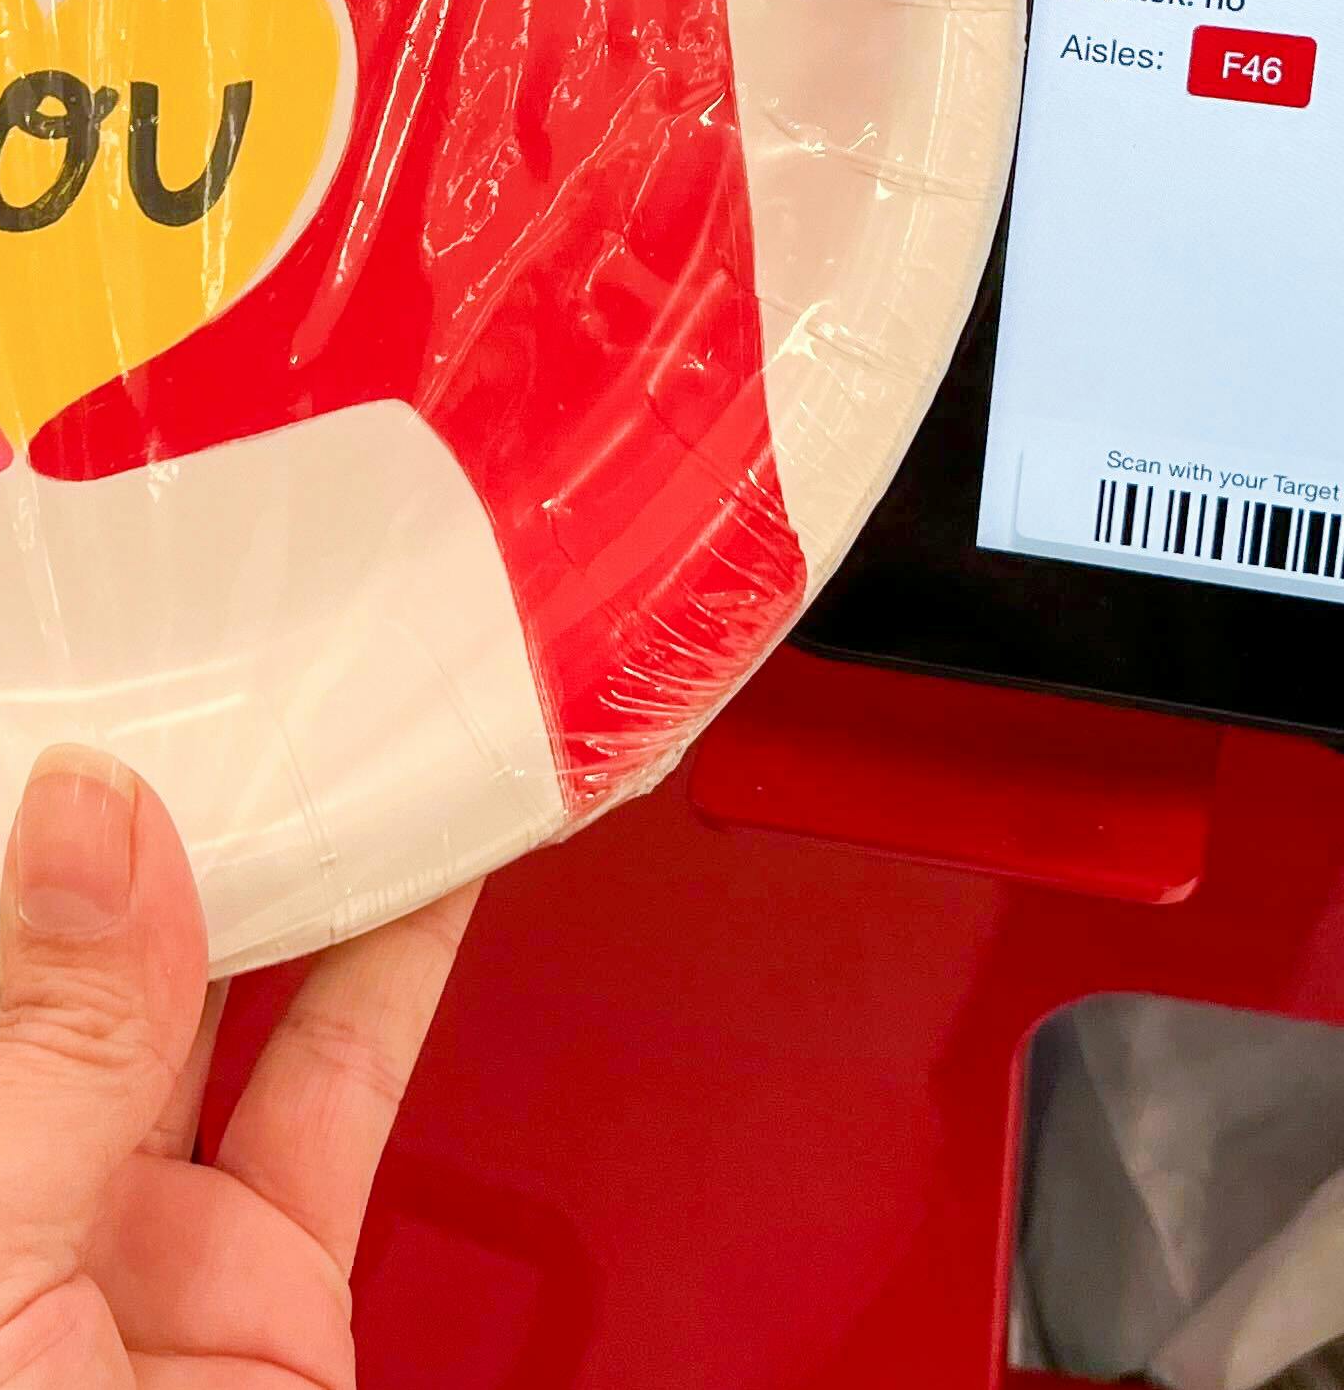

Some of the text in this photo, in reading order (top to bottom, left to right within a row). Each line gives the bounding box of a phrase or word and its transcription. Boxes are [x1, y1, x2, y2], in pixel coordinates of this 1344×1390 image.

[1060, 34, 1283, 83] Aisles: F46
[1107, 450, 1161, 476] Scan
[1168, 458, 1213, 483] with
[1219, 470, 1267, 493] your
[1272, 473, 1340, 503] Target
